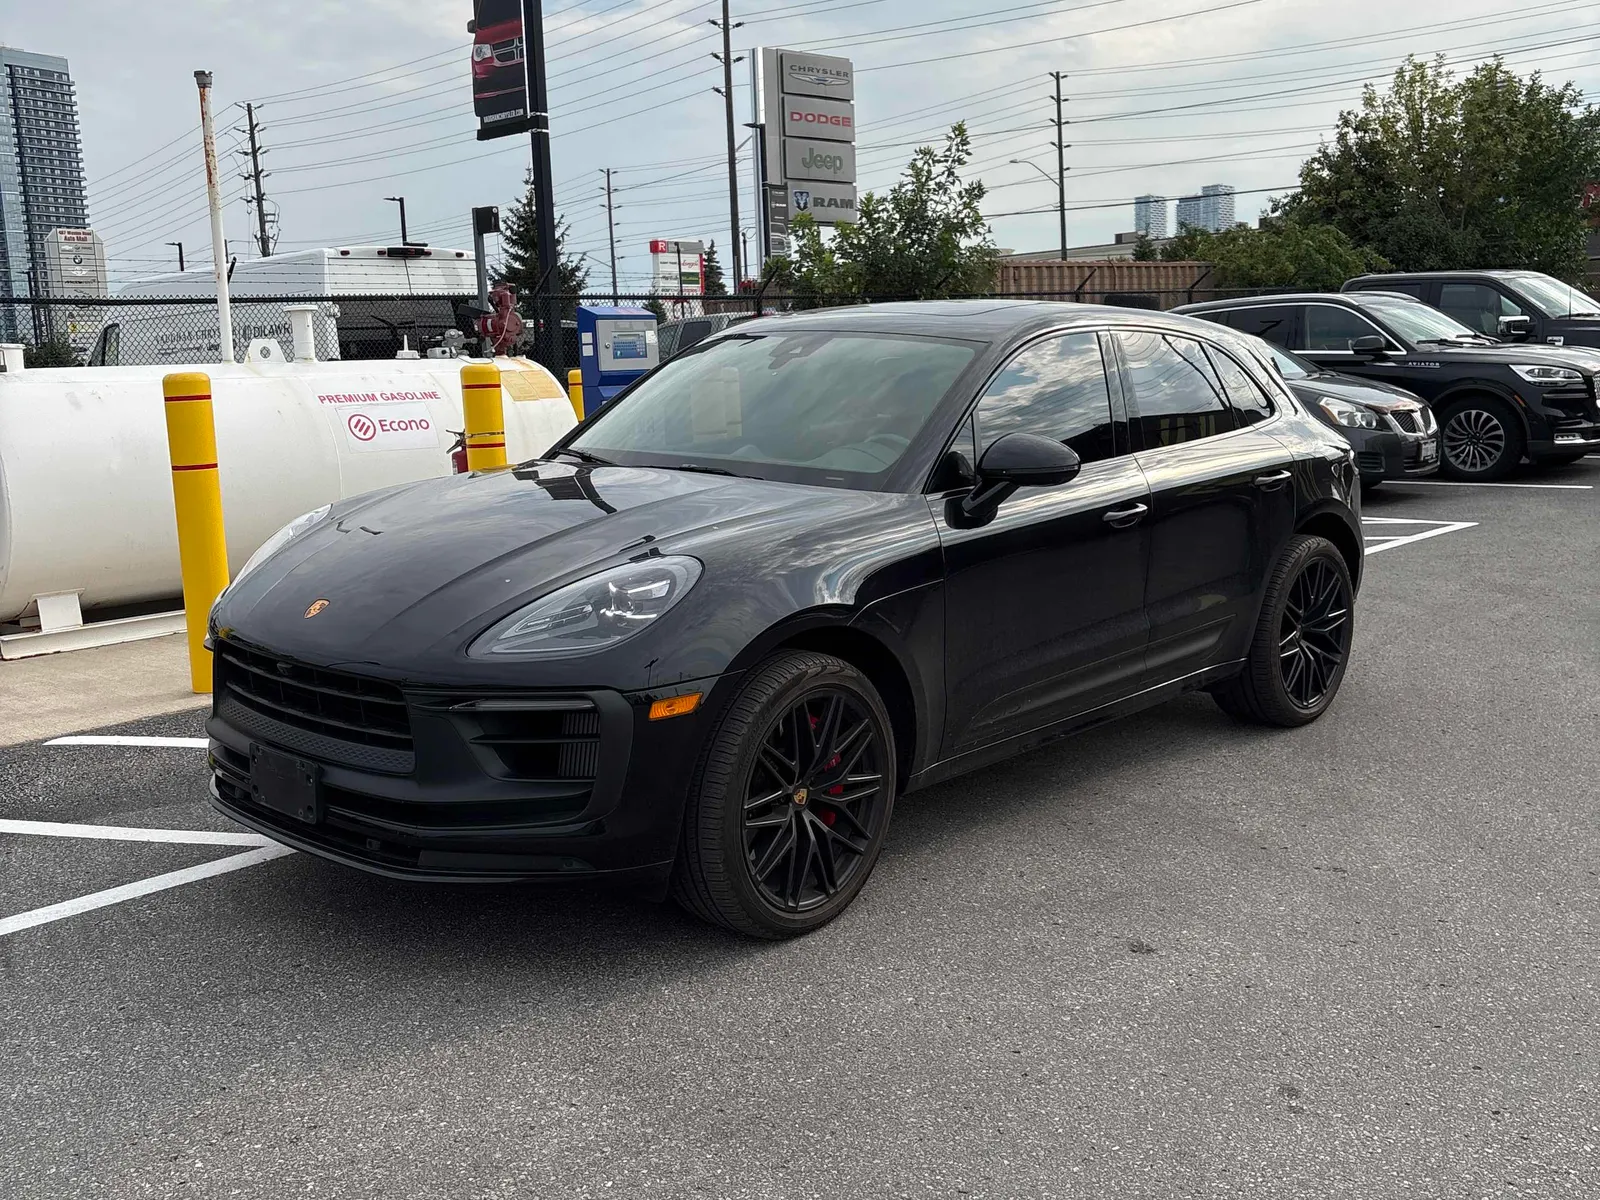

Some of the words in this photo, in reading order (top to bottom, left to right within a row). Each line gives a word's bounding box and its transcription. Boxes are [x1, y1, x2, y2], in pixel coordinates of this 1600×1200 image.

[789, 64, 849, 78] CHRYSLER
[790, 111, 852, 128] DODGE
[802, 147, 843, 174] Jeep
[813, 196, 854, 210] RAM
[658, 242, 666, 251] R
[317, 393, 379, 405] PREMIUM
[379, 391, 441, 402] GASOLINE
[378, 418, 430, 433] Econo
